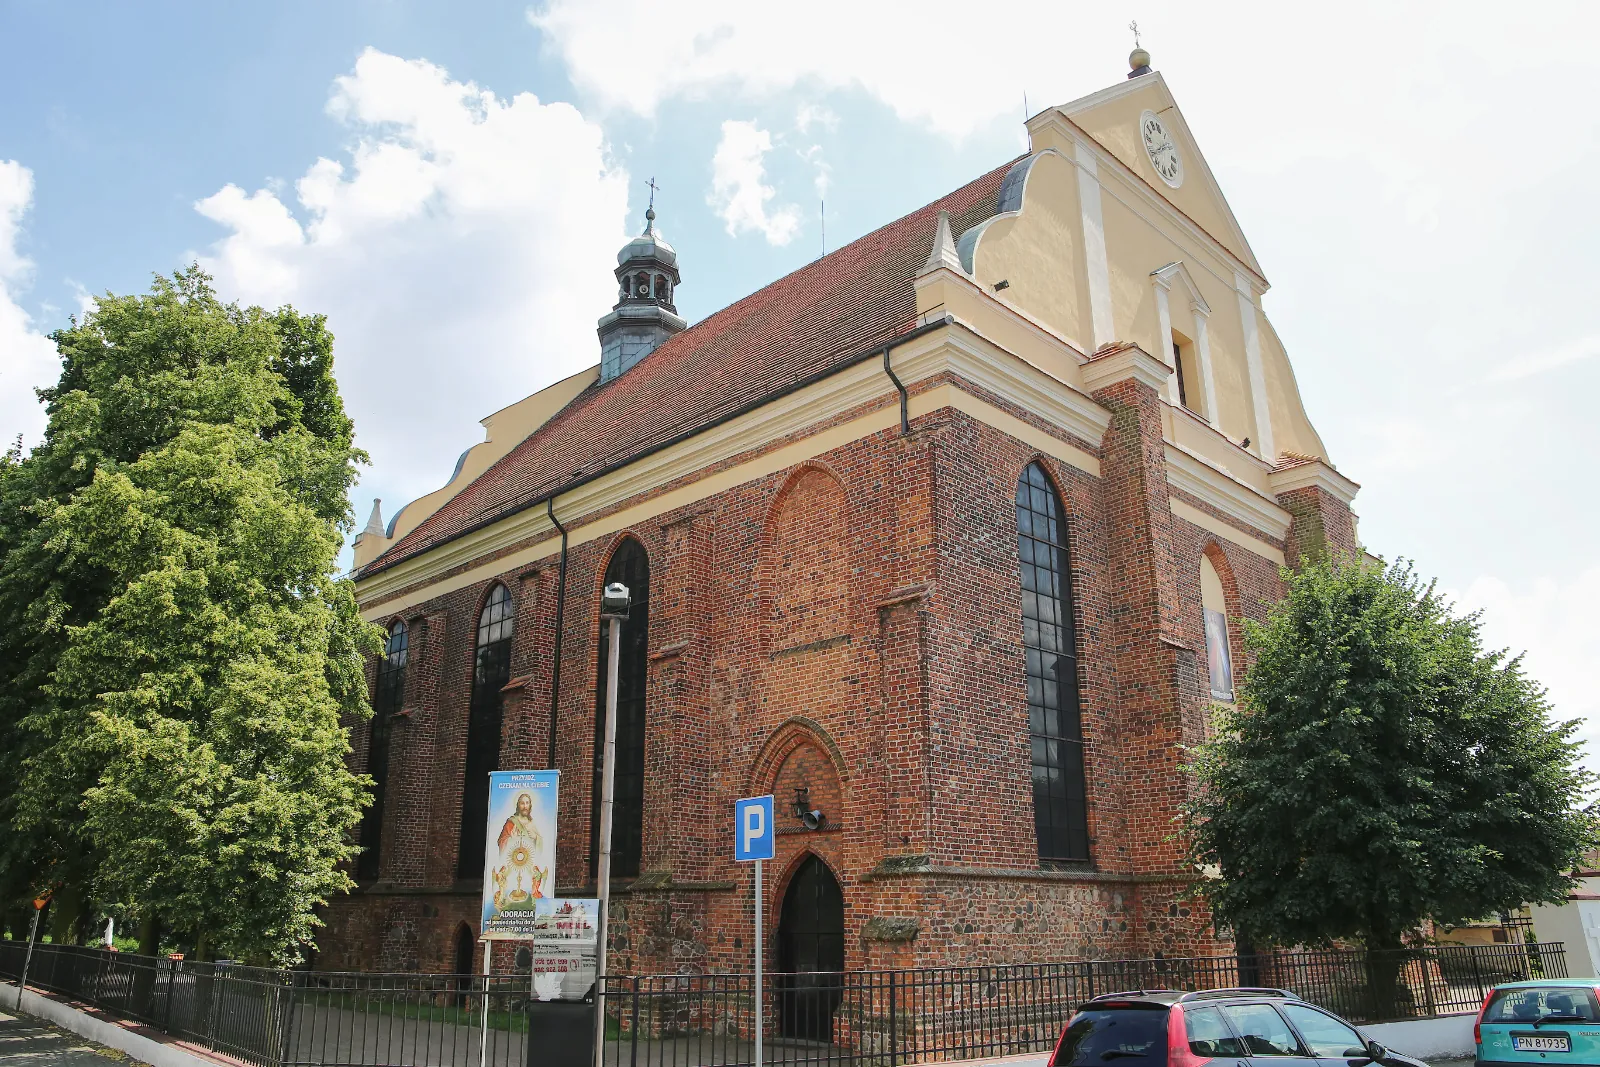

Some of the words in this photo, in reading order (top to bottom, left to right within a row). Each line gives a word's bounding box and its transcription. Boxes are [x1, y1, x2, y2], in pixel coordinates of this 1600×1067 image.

[744, 805, 765, 853] P
[500, 910, 534, 918] ADORACJA
[1519, 1039, 1532, 1048] PN
[1535, 1038, 1566, 1048] 81935
